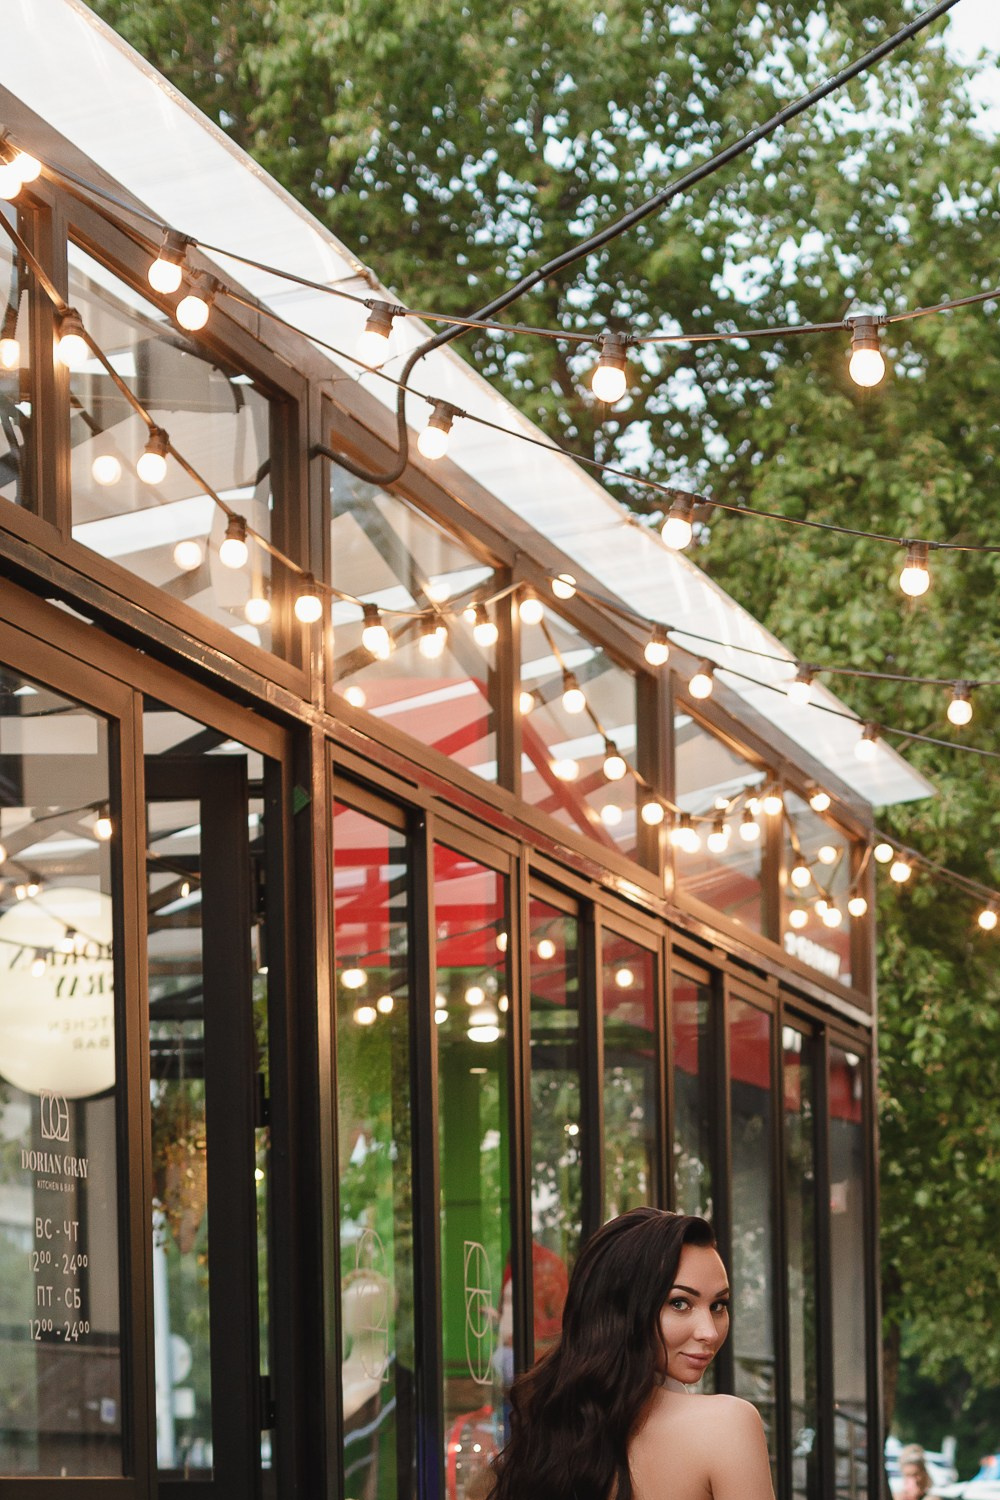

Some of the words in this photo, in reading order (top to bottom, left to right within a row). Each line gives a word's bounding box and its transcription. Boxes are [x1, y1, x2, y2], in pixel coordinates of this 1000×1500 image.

[21, 1149, 61, 1174] DORIAN
[63, 1155, 89, 1178] GRAY
[35, 1217, 53, 1239] ВС
[63, 1221, 79, 1242] ЧТ
[37, 1285, 53, 1307] ПТ
[64, 1287, 81, 1308] СБ
